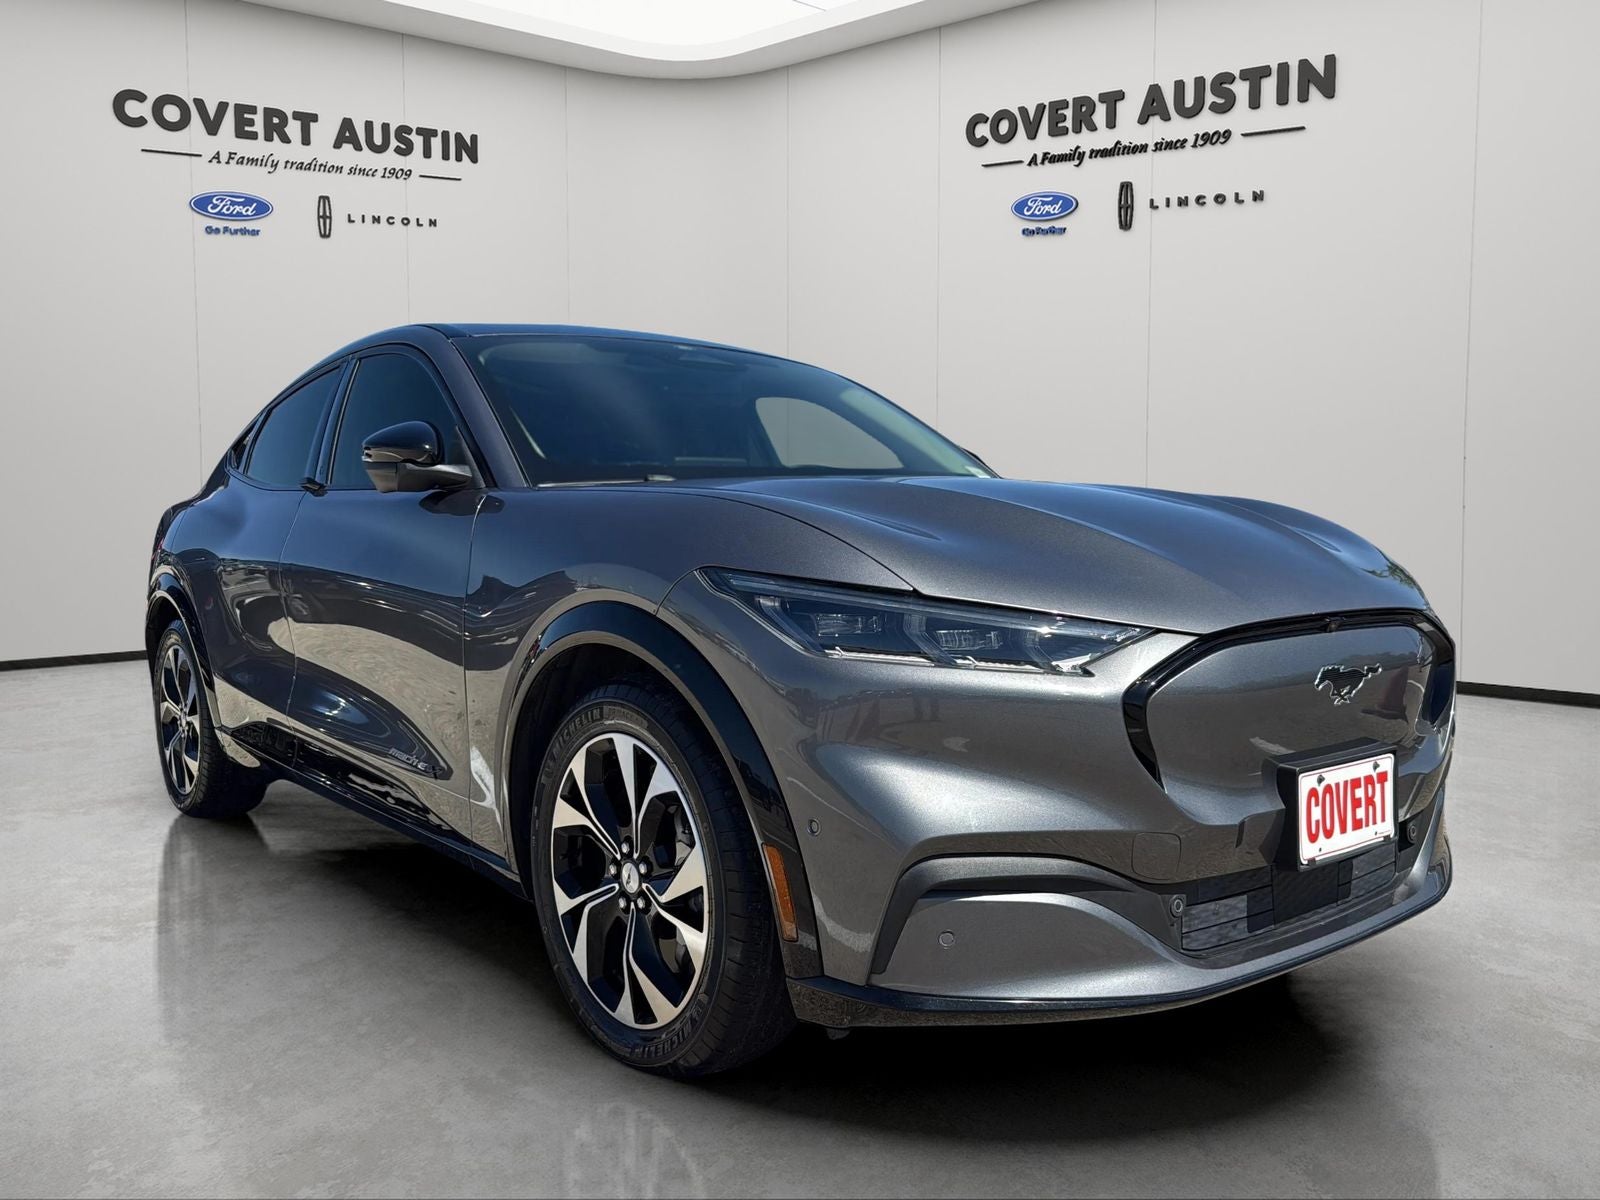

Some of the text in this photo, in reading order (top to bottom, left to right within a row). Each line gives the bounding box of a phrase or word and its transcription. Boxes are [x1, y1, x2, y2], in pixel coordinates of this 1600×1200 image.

[966, 54, 1337, 149] COVERT AUSTIN
[112, 88, 479, 165] COVERT AUSTIN
[1027, 128, 1233, 168] A Family tradition since 1909
[208, 150, 413, 181] A Family tradition since 1909
[207, 195, 258, 216] Ford
[1023, 196, 1064, 216] Ford
[1149, 189, 1265, 211] LINCOLN
[204, 225, 261, 237] Go Further
[347, 213, 438, 228] LINCOLN
[551, 707, 601, 760] MICHELIN
[1305, 770, 1389, 844] COVERT
